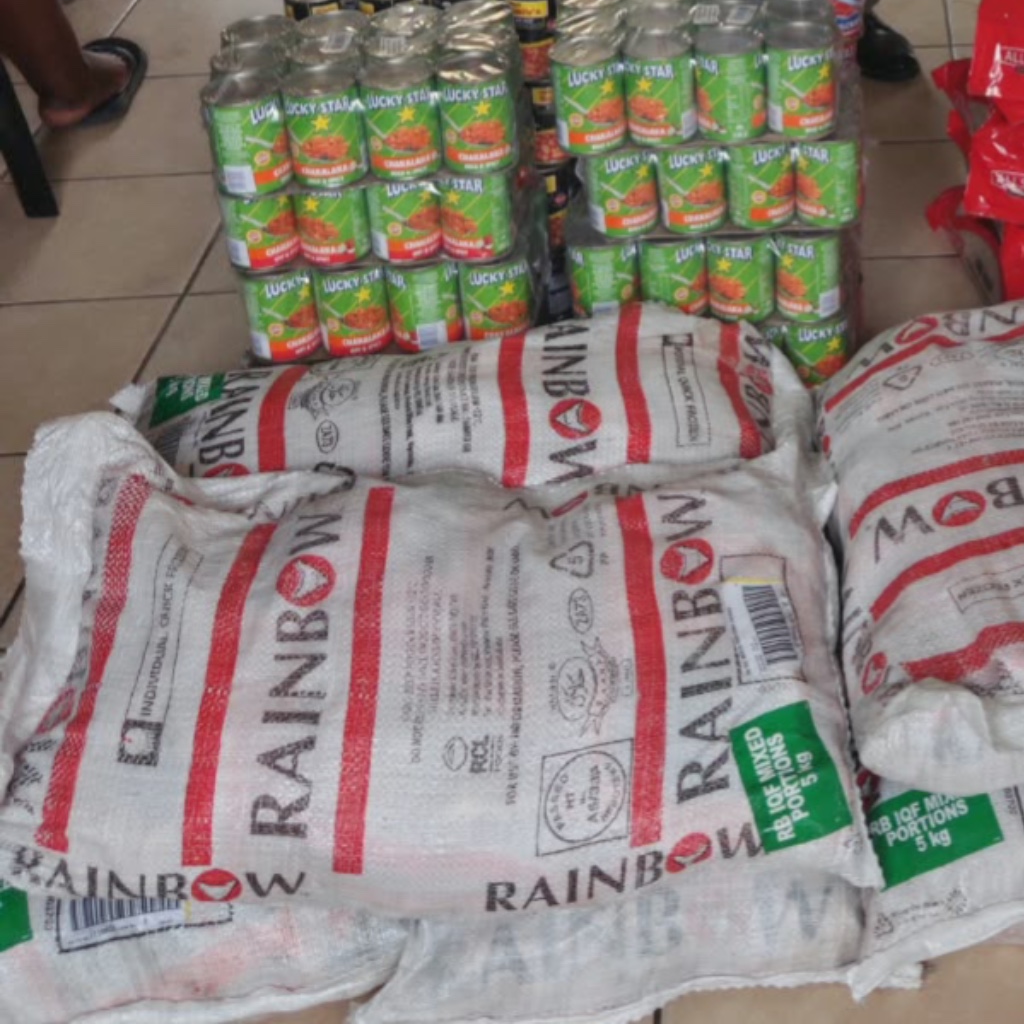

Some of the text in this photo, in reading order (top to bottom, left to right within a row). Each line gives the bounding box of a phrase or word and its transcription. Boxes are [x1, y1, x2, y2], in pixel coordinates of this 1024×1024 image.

[568, 68, 604, 89] LUCKY
[643, 64, 675, 80] STAR
[669, 152, 705, 169] LUCKY
[724, 244, 753, 261] STAR
[799, 327, 833, 342] LUCKY
[140, 635, 169, 717] INDIVIDUAL
[159, 582, 175, 628] QUICK
[660, 494, 734, 804] RAINBOW
[250, 512, 342, 839] RAINBOW
[469, 735, 490, 774] RCL
[743, 725, 775, 783] MIXED
[796, 750, 819, 788] 5 kg
[766, 731, 810, 822] PORTIONS
[773, 814, 797, 844] RB
[884, 799, 969, 847] PORTIONS
[893, 801, 922, 826] IQF
[915, 828, 953, 853] 5 kg
[12, 845, 306, 903] RAINBOW
[485, 823, 766, 913] RAINBOW
